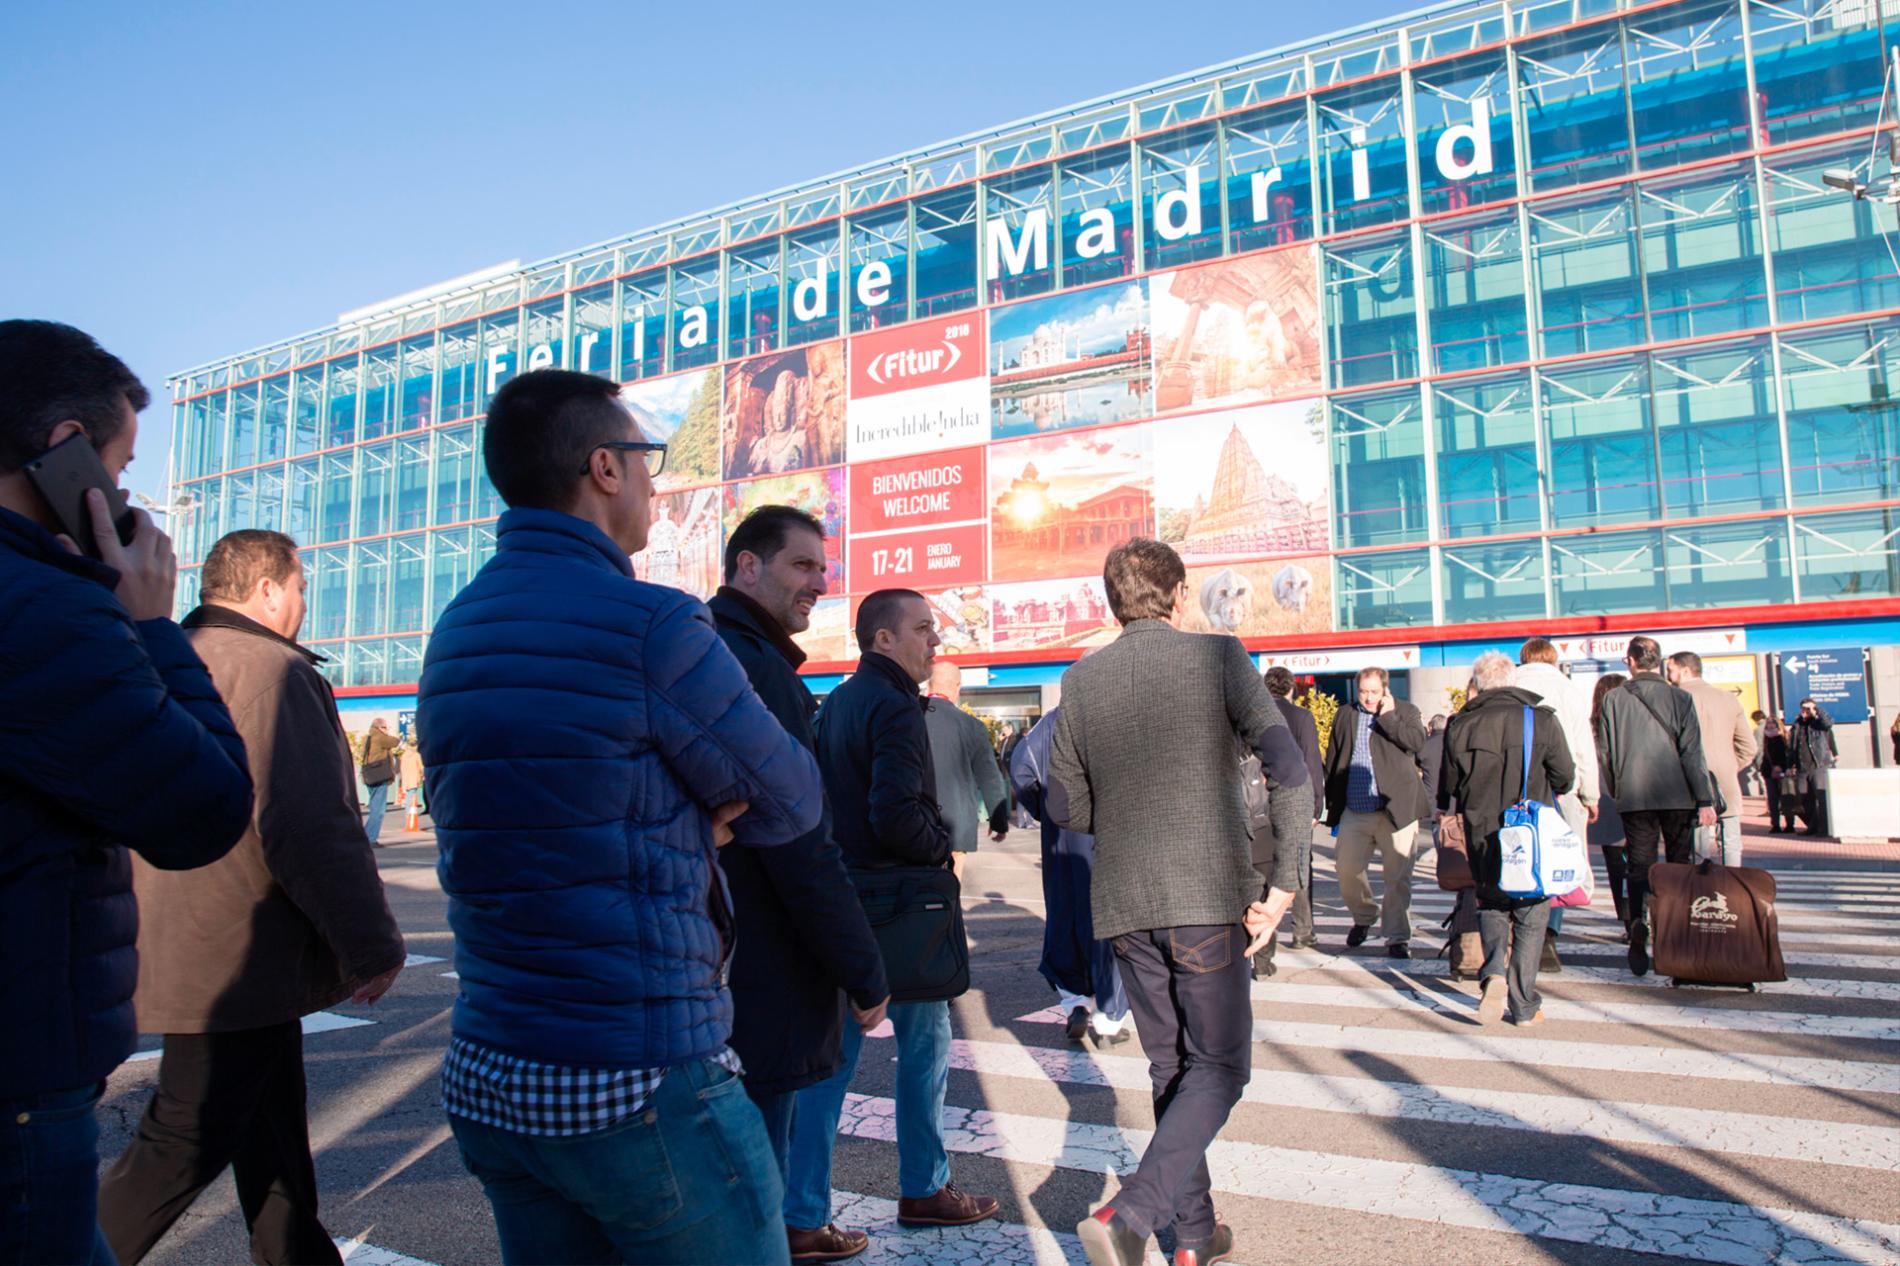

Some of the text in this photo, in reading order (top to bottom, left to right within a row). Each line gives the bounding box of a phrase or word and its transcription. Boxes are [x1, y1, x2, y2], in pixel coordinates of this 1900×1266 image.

[486, 97, 1493, 395] Feria de Madrid
[945, 323, 970, 340] 2018
[884, 348, 944, 379] Fitur
[856, 413, 937, 444] Incredible
[872, 465, 962, 495] BIENVENIDOS
[883, 491, 951, 518] WELCOME
[871, 546, 913, 576] 17-21
[927, 542, 952, 557] ENERO
[927, 555, 961, 570] JANUARY
[1589, 640, 1625, 653] Fitur
[1291, 656, 1321, 667] Fitur
